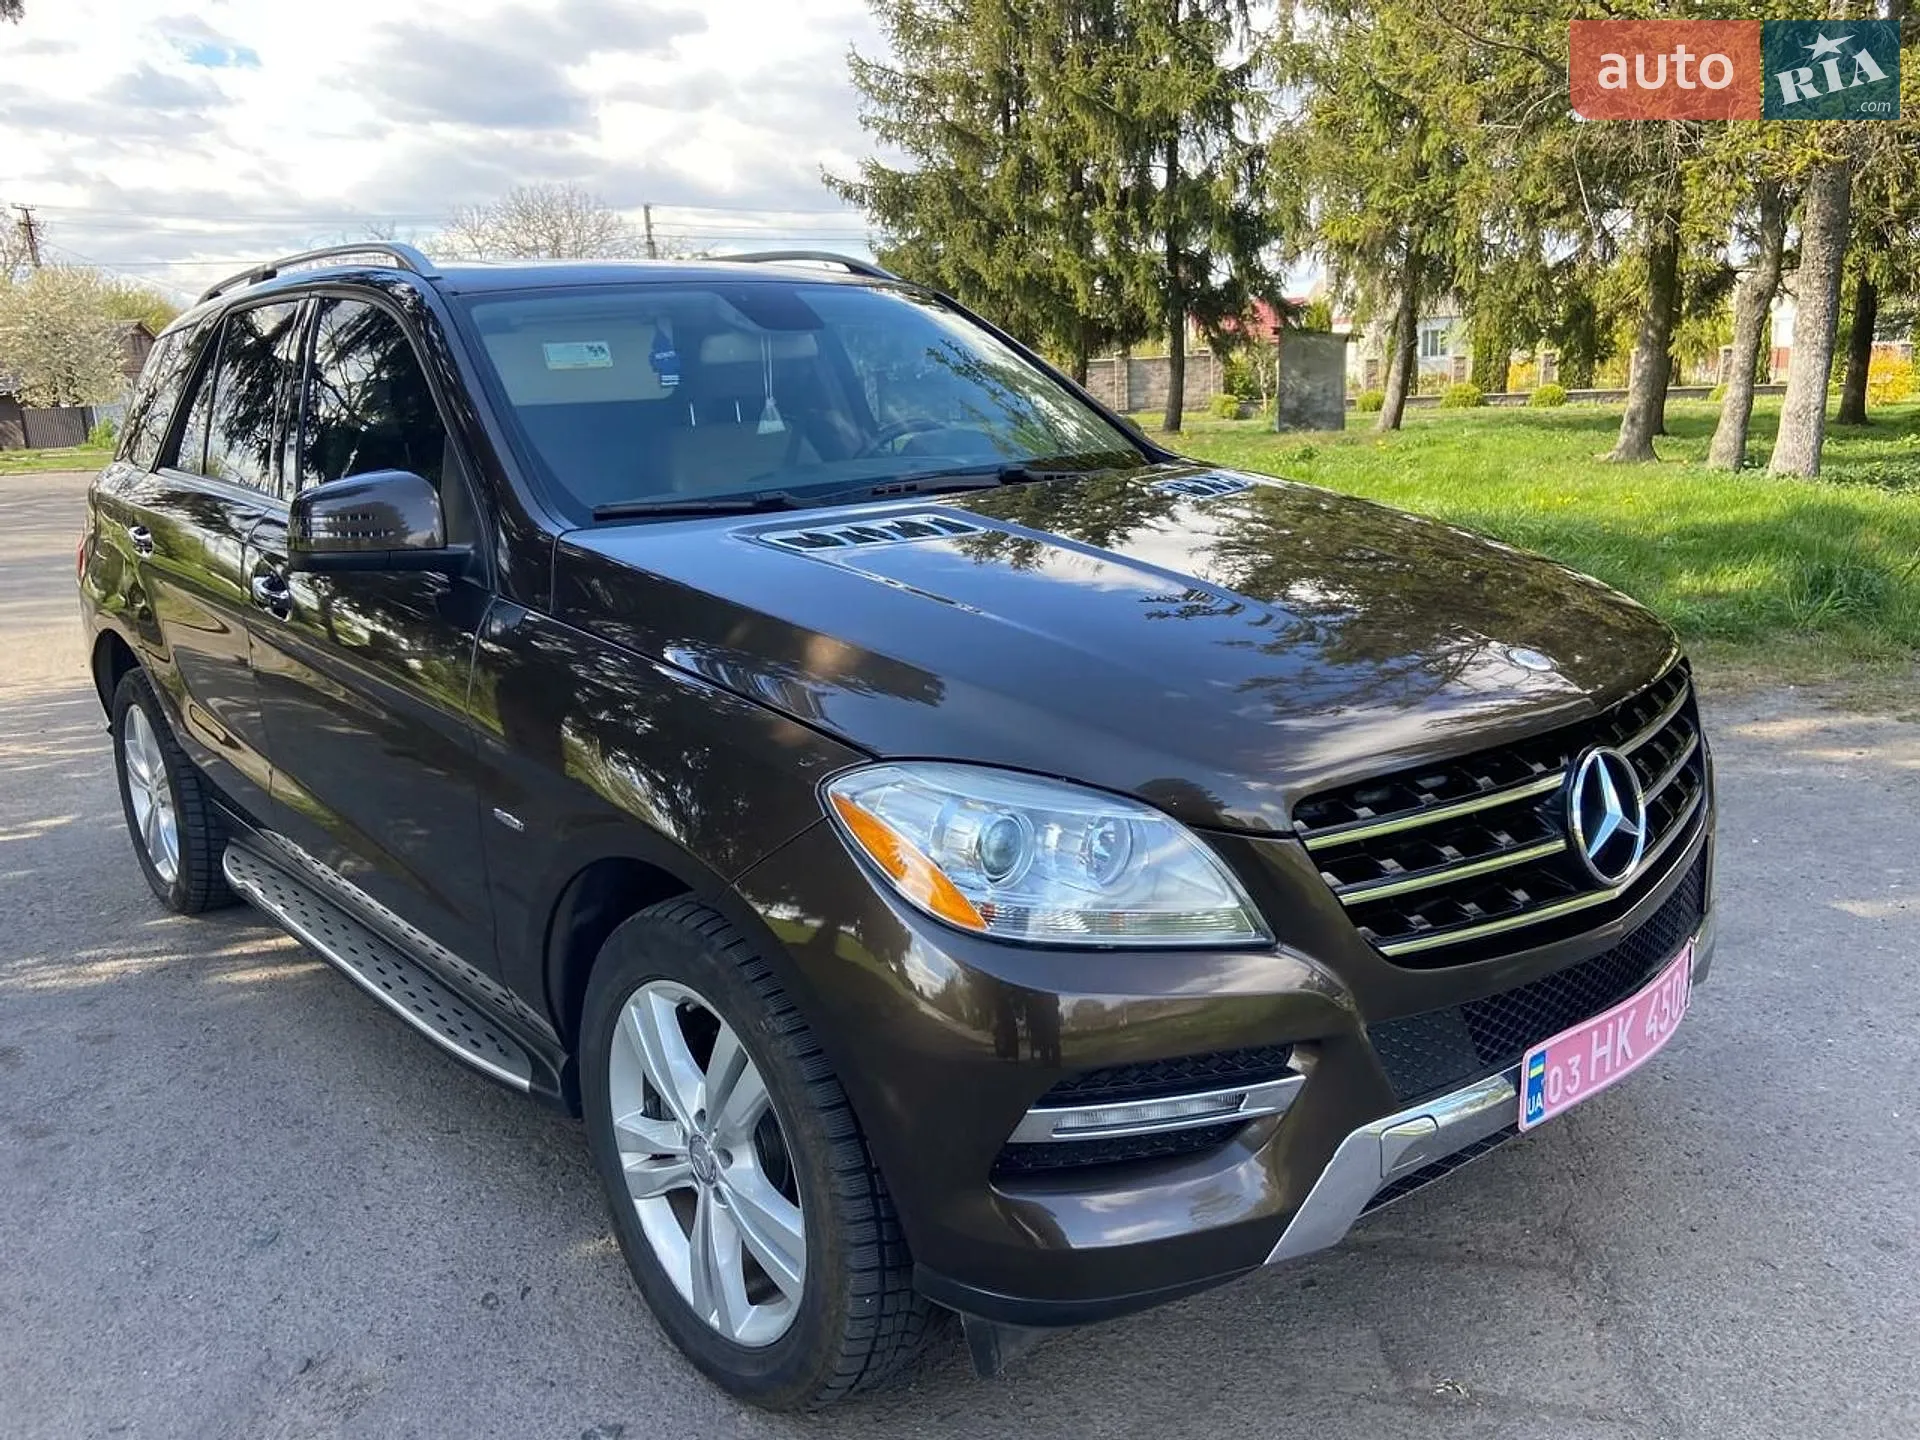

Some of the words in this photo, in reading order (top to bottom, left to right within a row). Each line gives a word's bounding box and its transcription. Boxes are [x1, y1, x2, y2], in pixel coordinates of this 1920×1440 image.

[1548, 1054, 1581, 1104] 03
[1590, 1010, 1637, 1081] HK
[1527, 1091, 1543, 1115] UA
